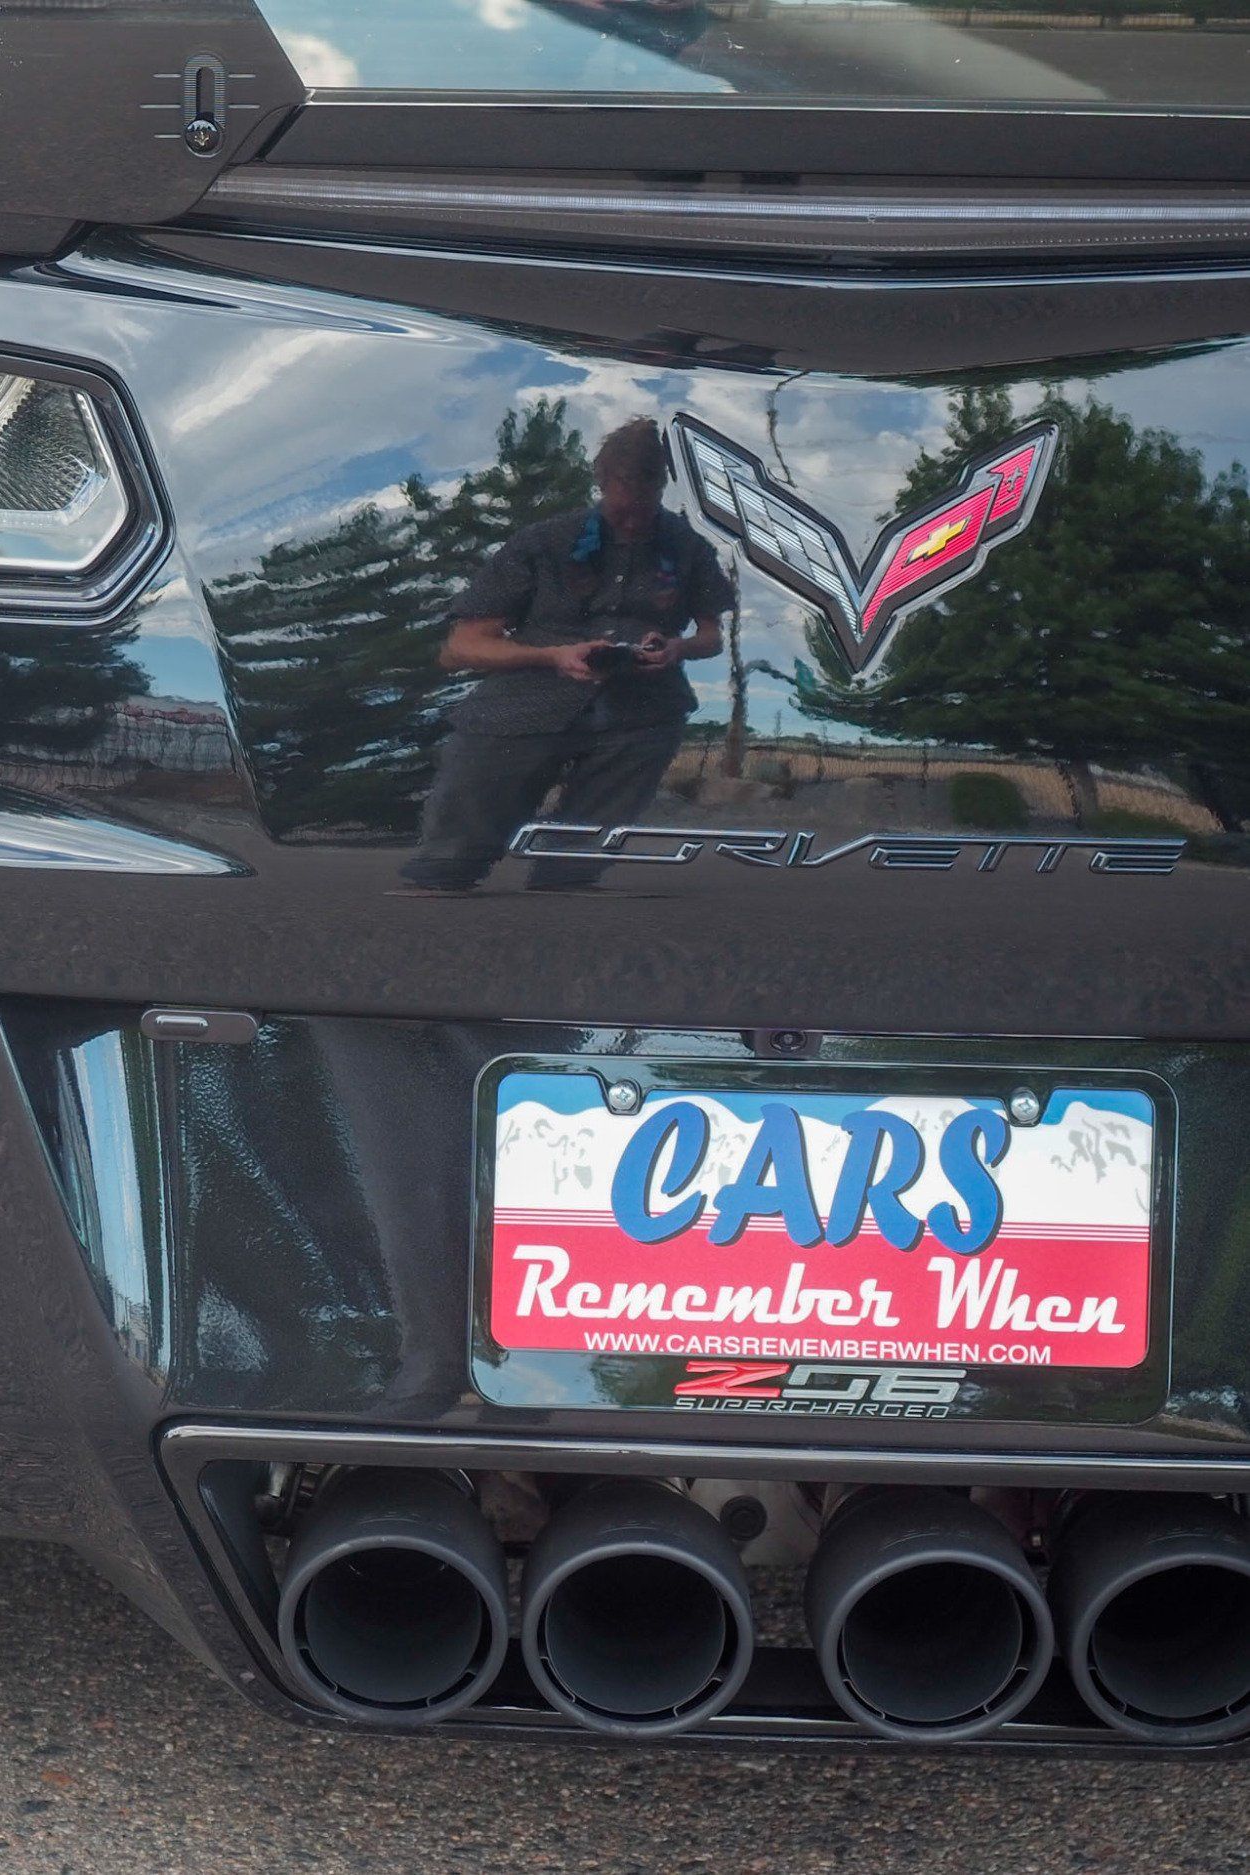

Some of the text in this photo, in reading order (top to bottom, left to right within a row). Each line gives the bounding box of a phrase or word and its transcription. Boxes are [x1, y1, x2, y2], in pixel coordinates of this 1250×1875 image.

[508, 822, 1188, 876] CORVETTE
[610, 1101, 1011, 1255] CARS
[512, 1244, 1126, 1334] Remember When
[584, 1331, 1052, 1365] WWW.CARSREMEMBERWHEN.COM
[673, 1397, 950, 1419] SUPERCHARGED
